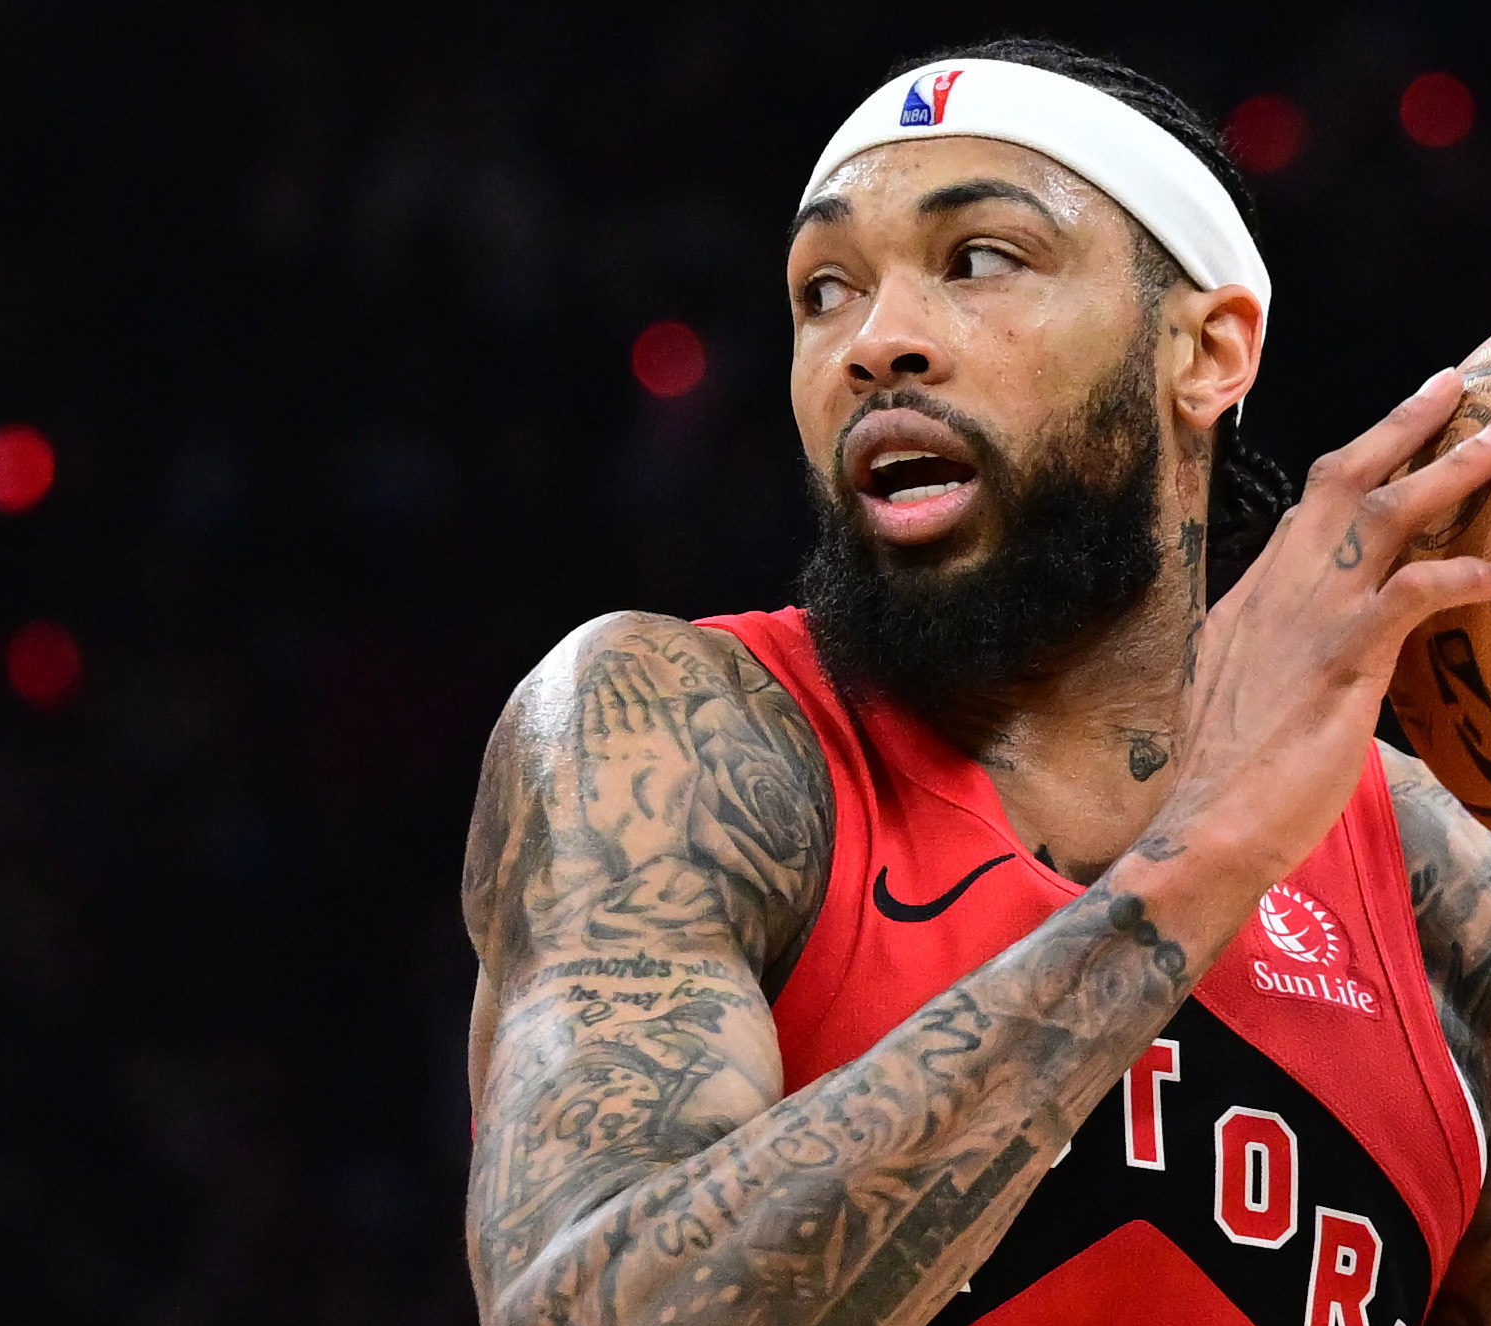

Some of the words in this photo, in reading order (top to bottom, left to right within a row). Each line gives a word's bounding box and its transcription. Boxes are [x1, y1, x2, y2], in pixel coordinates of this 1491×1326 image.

[902, 108, 929, 124] NBA
[1253, 960, 1318, 998] Sun
[1316, 973, 1376, 1014] Life
